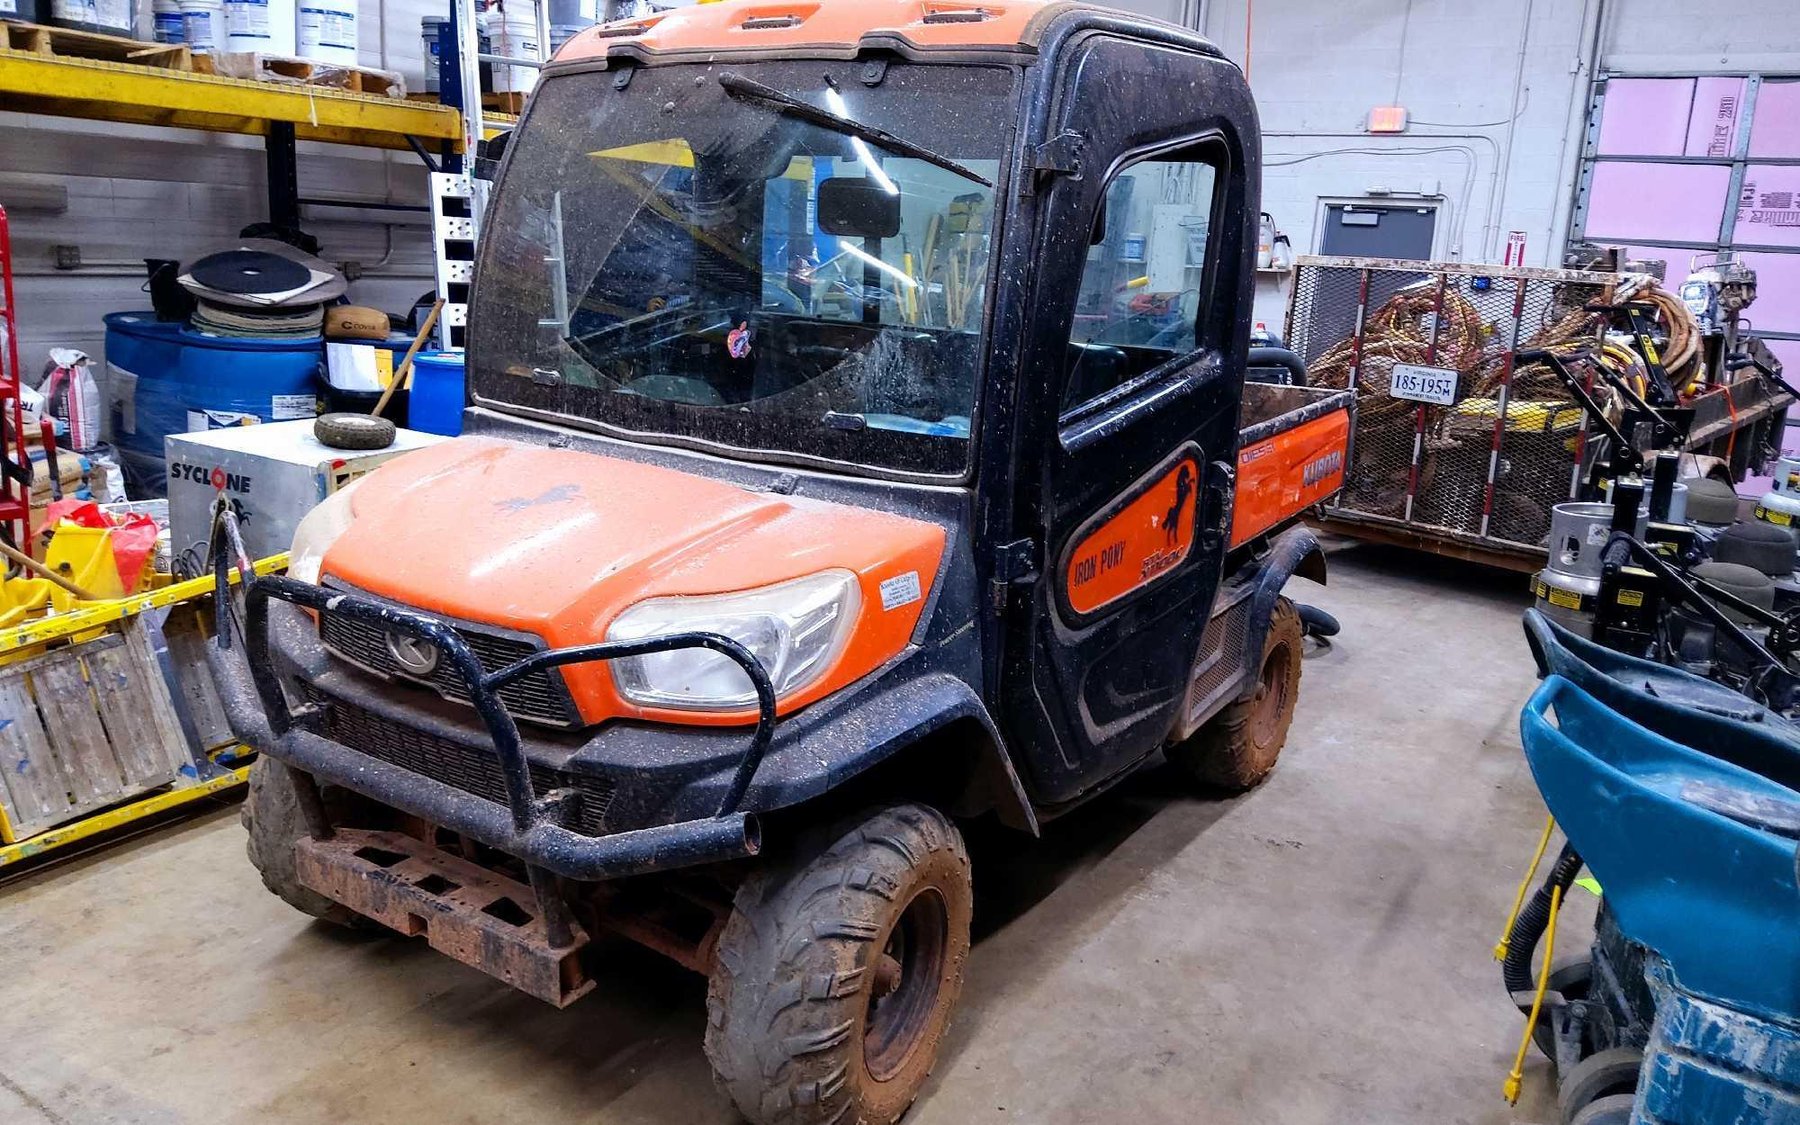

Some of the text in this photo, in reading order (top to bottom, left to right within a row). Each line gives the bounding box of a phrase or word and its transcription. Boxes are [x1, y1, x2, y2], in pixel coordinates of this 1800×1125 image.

[1395, 374, 1442, 395] 185-195
[171, 462, 251, 493] SYCLONE
[1074, 554, 1097, 588] IRON
[1100, 540, 1127, 575] PONY
